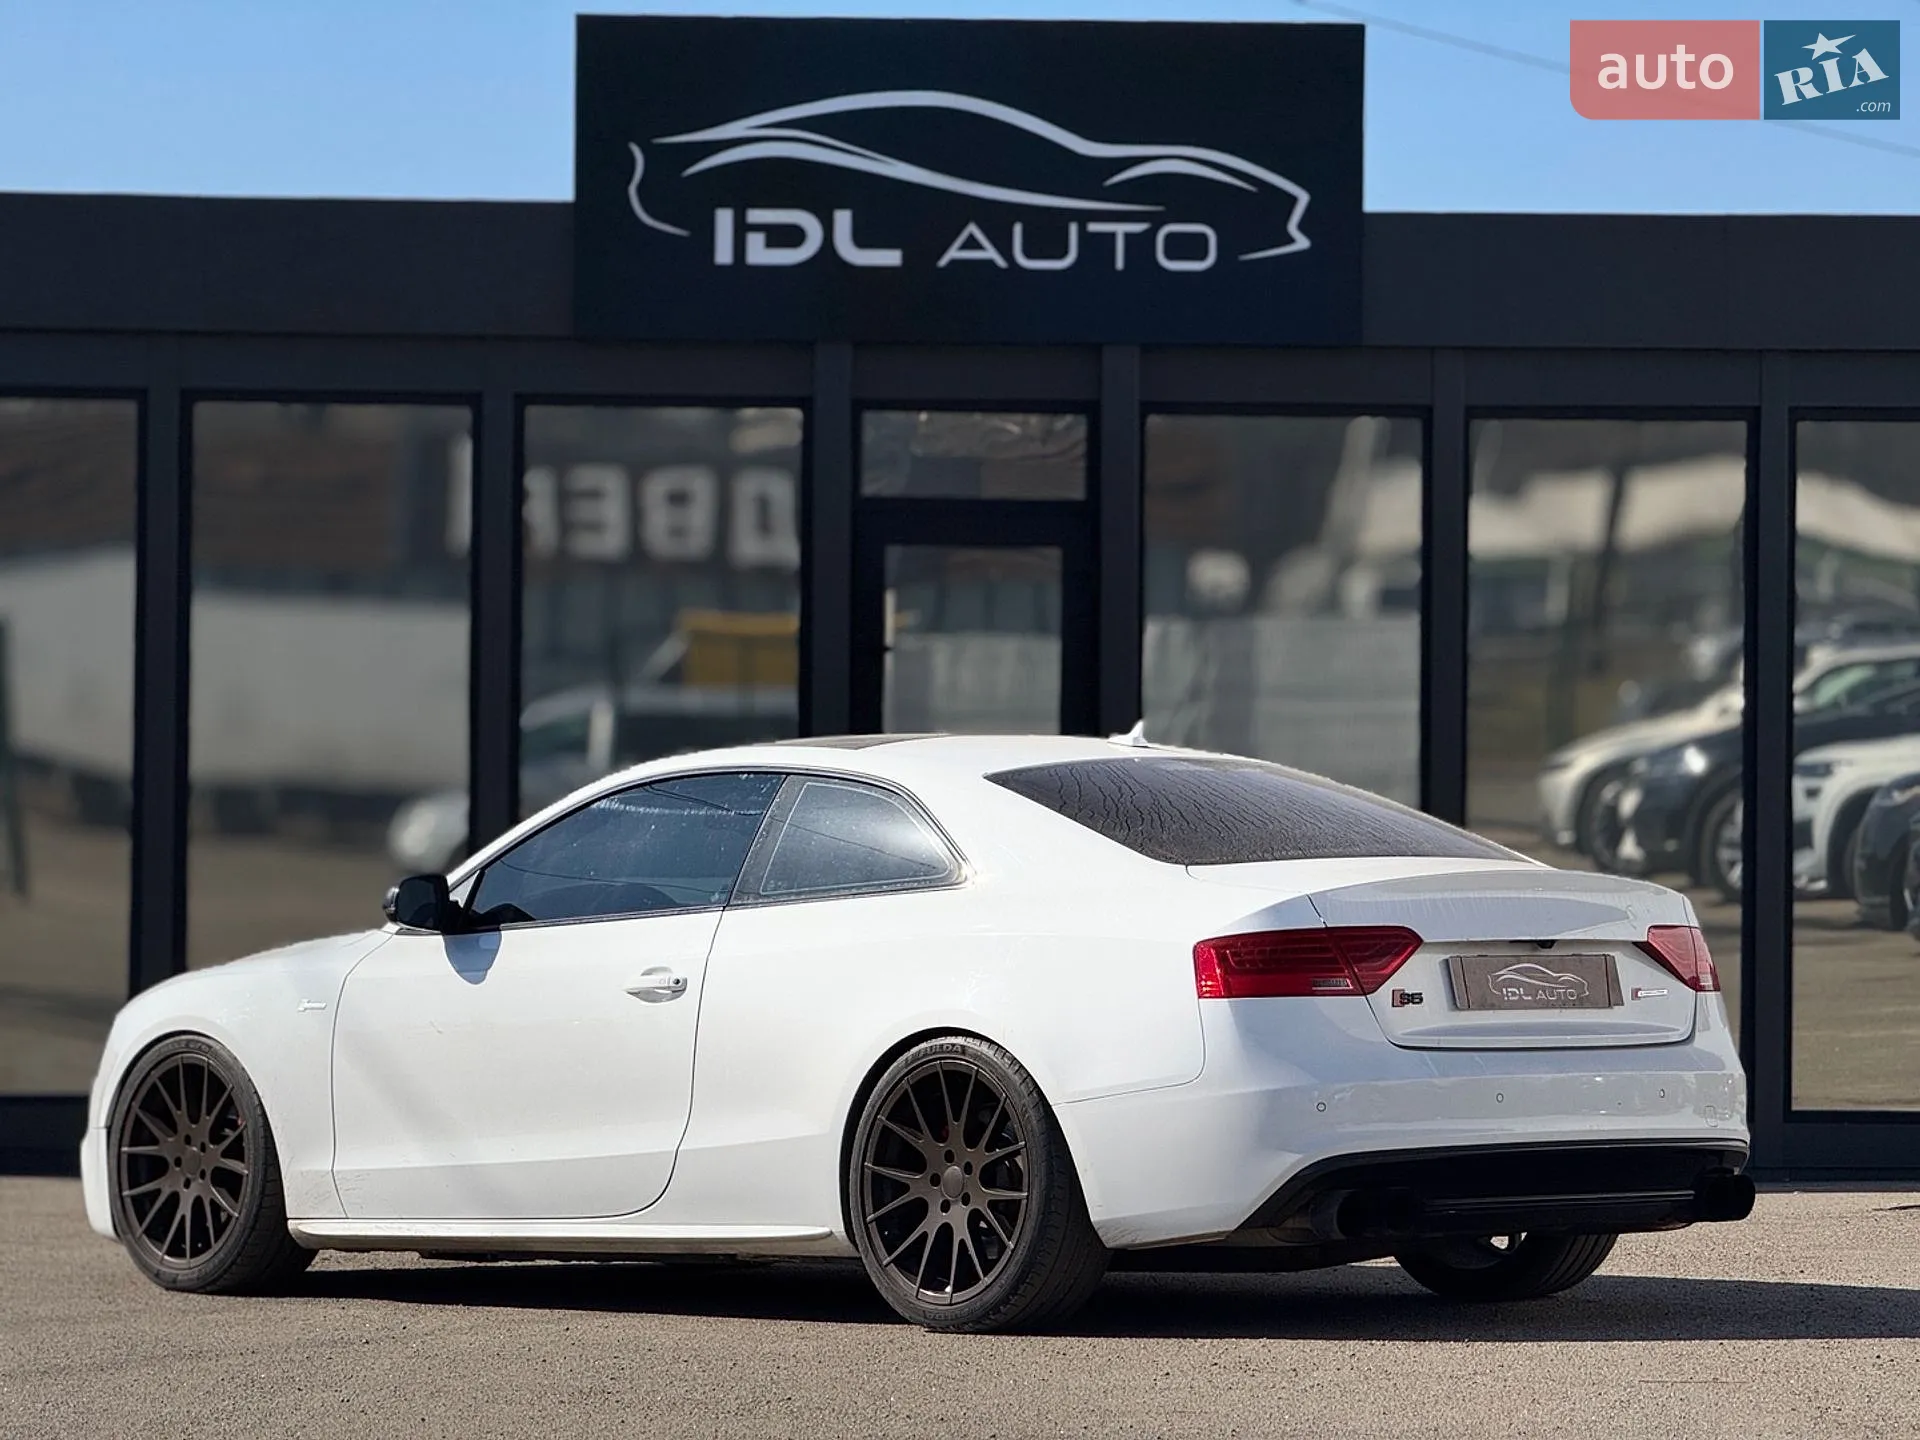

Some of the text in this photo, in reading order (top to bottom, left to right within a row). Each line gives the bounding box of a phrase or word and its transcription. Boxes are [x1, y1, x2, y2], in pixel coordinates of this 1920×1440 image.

[714, 208, 1217, 272] IDL AUTO
[1502, 987, 1577, 1001] IDL AUTO
